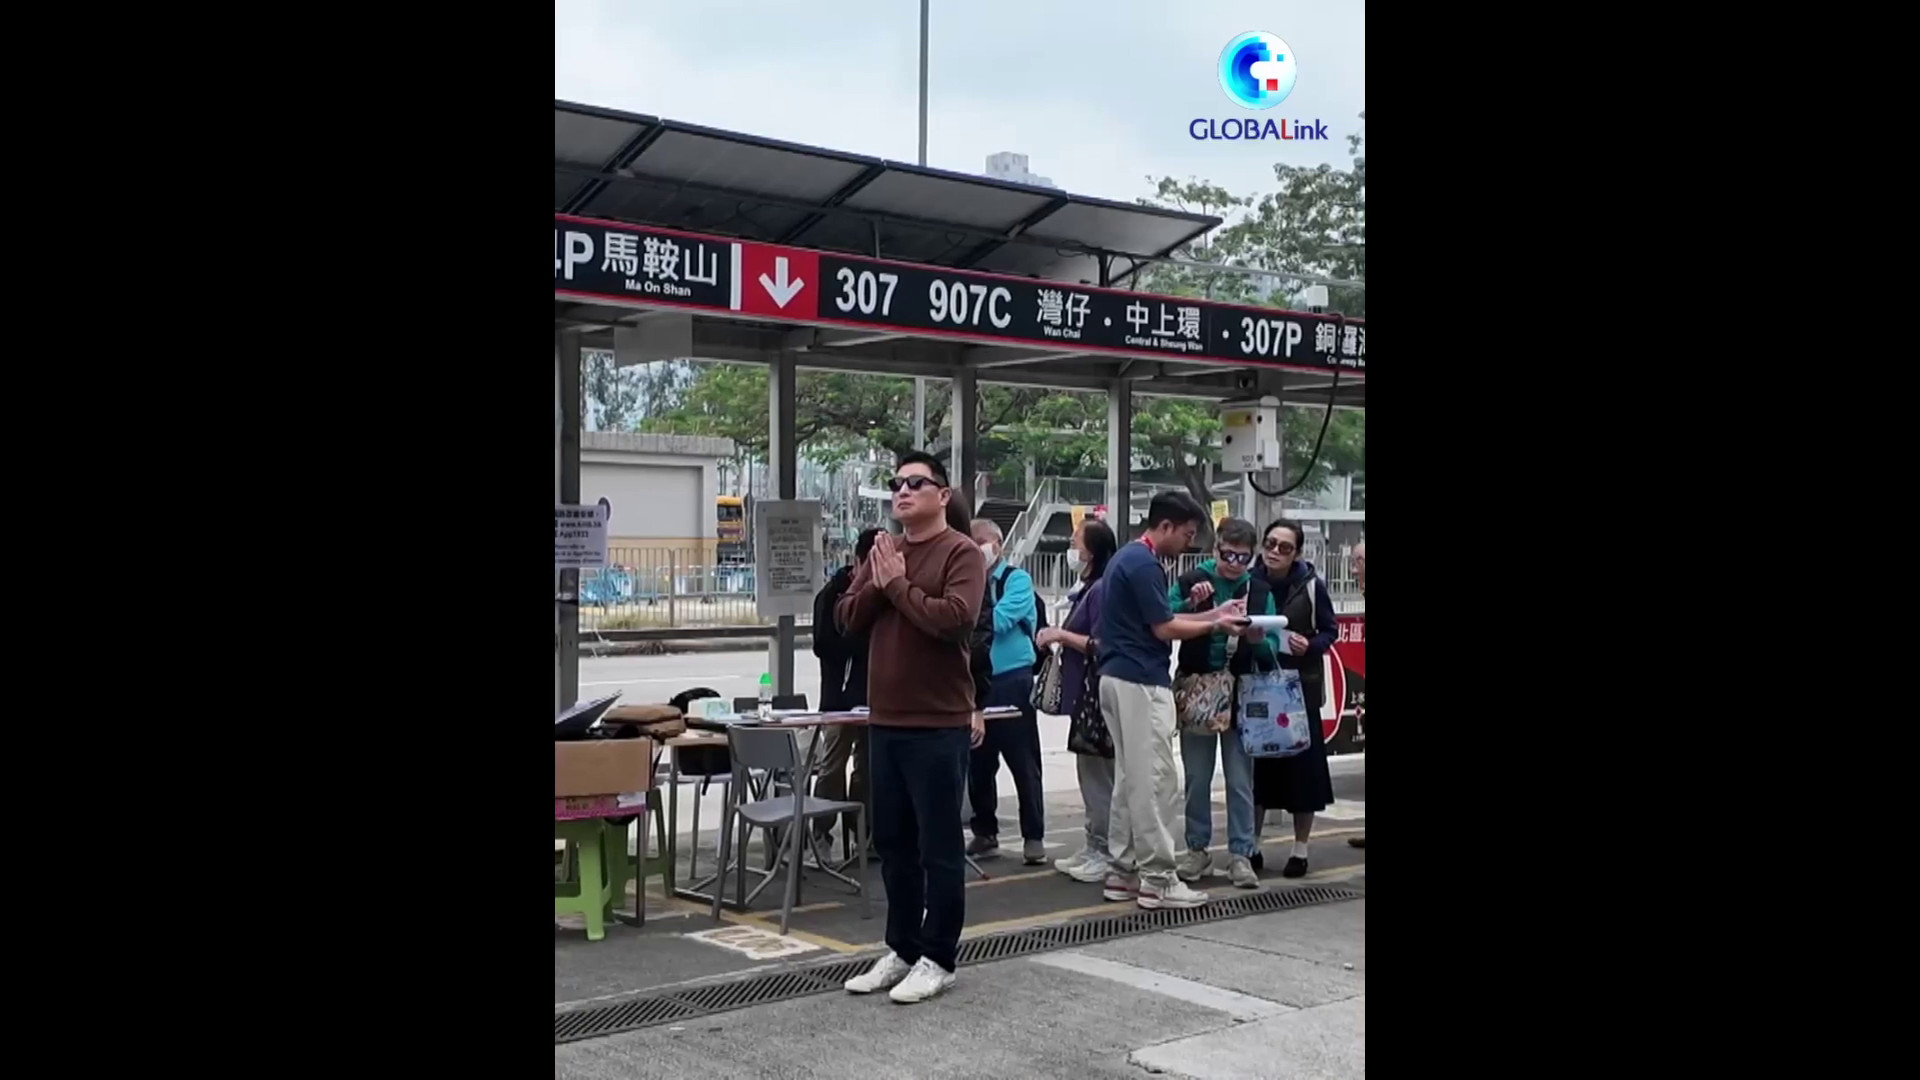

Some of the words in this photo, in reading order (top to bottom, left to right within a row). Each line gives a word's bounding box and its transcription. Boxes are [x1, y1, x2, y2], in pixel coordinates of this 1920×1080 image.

[555, 228, 594, 280] P
[601, 231, 717, 286] 馬鞍山
[625, 279, 641, 291] Ma
[644, 281, 660, 292] On
[663, 283, 691, 296] Shan
[835, 267, 898, 316] 307
[929, 279, 1011, 328] 907C
[1036, 288, 1091, 327] 灣仔
[1126, 300, 1200, 340] 中上環
[1043, 326, 1061, 337] Wan
[1063, 327, 1081, 339] Chai
[1125, 335, 1151, 347] Central
[1160, 338, 1186, 352] Sheung
[1187, 341, 1203, 352] Wan
[1241, 317, 1302, 358] 307P
[1335, 623, 1365, 642] 北區
